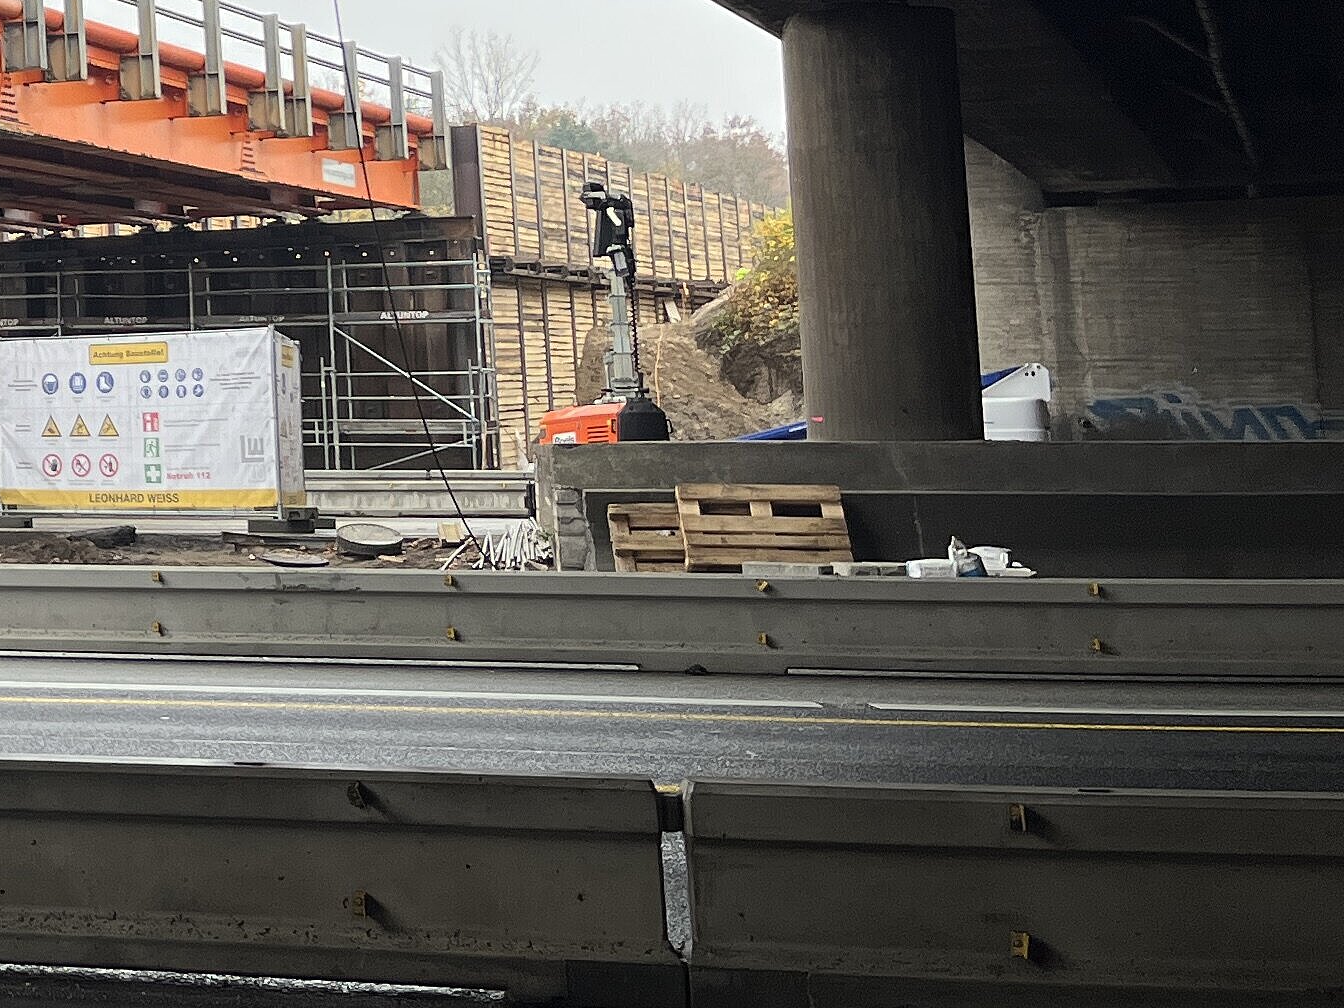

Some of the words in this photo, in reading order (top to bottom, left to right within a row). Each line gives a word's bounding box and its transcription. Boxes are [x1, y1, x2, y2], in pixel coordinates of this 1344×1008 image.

[103, 316, 148, 325] ALTUNTOP
[89, 492, 145, 503] LEONHARD
[147, 492, 180, 503] WEISS
